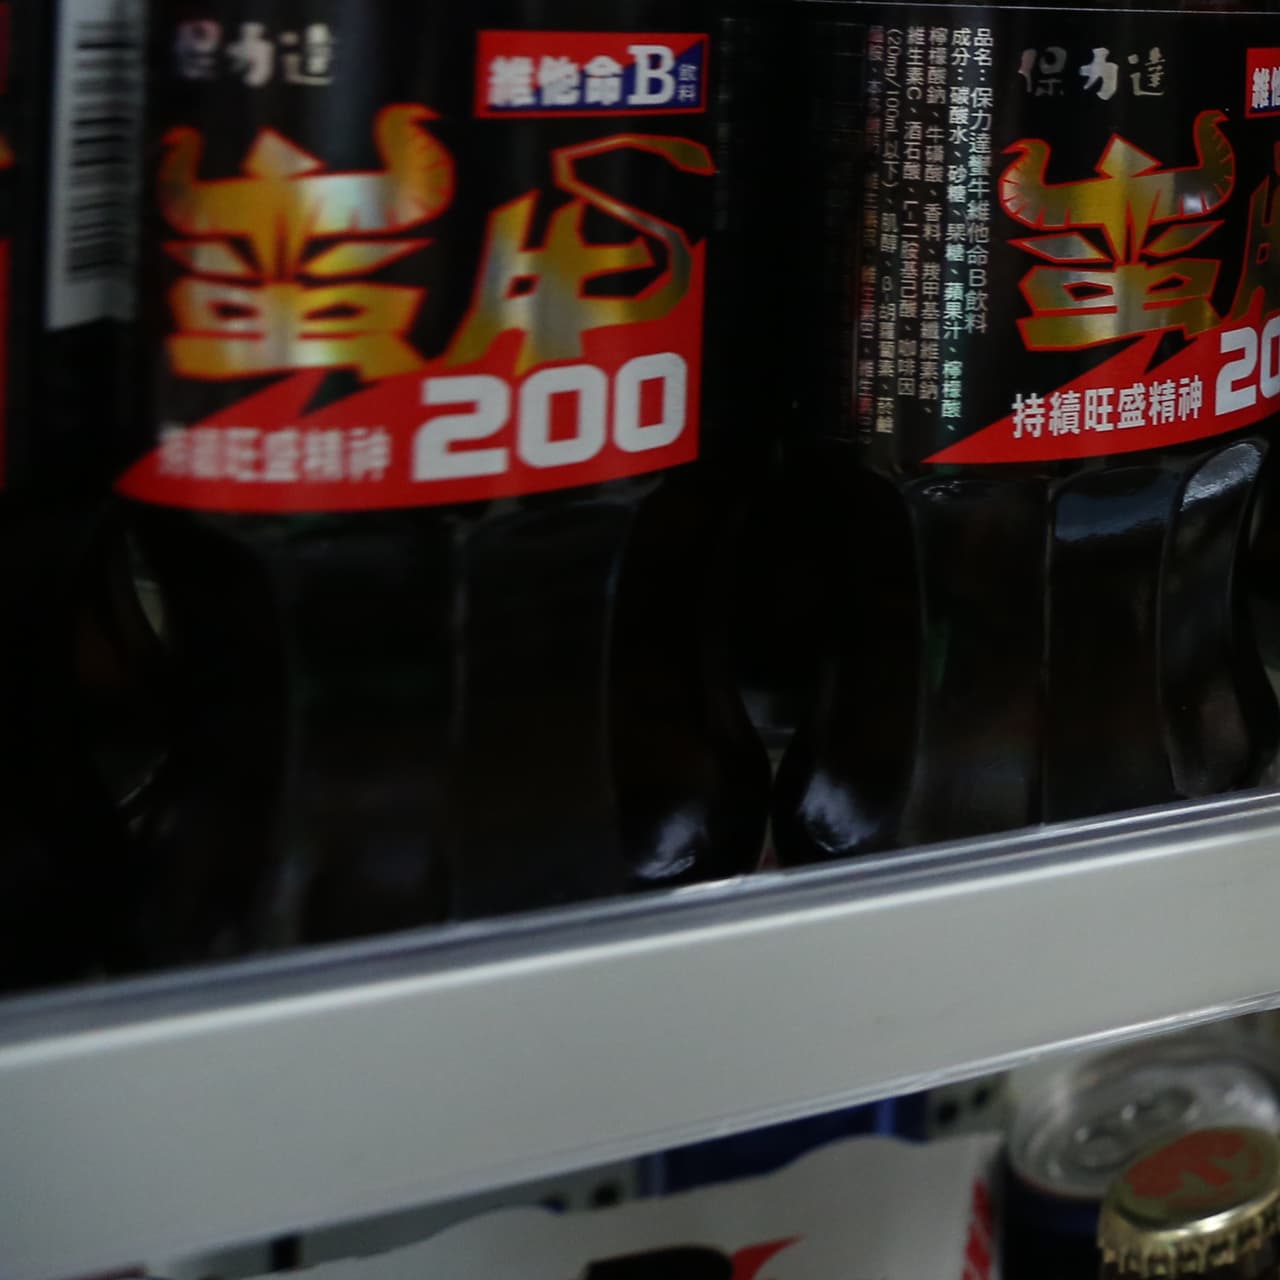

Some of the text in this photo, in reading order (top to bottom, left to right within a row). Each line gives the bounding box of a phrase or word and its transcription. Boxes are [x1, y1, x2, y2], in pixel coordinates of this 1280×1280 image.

[412, 352, 687, 482] 200
[1012, 375, 1202, 438] 持續旺盛精神
